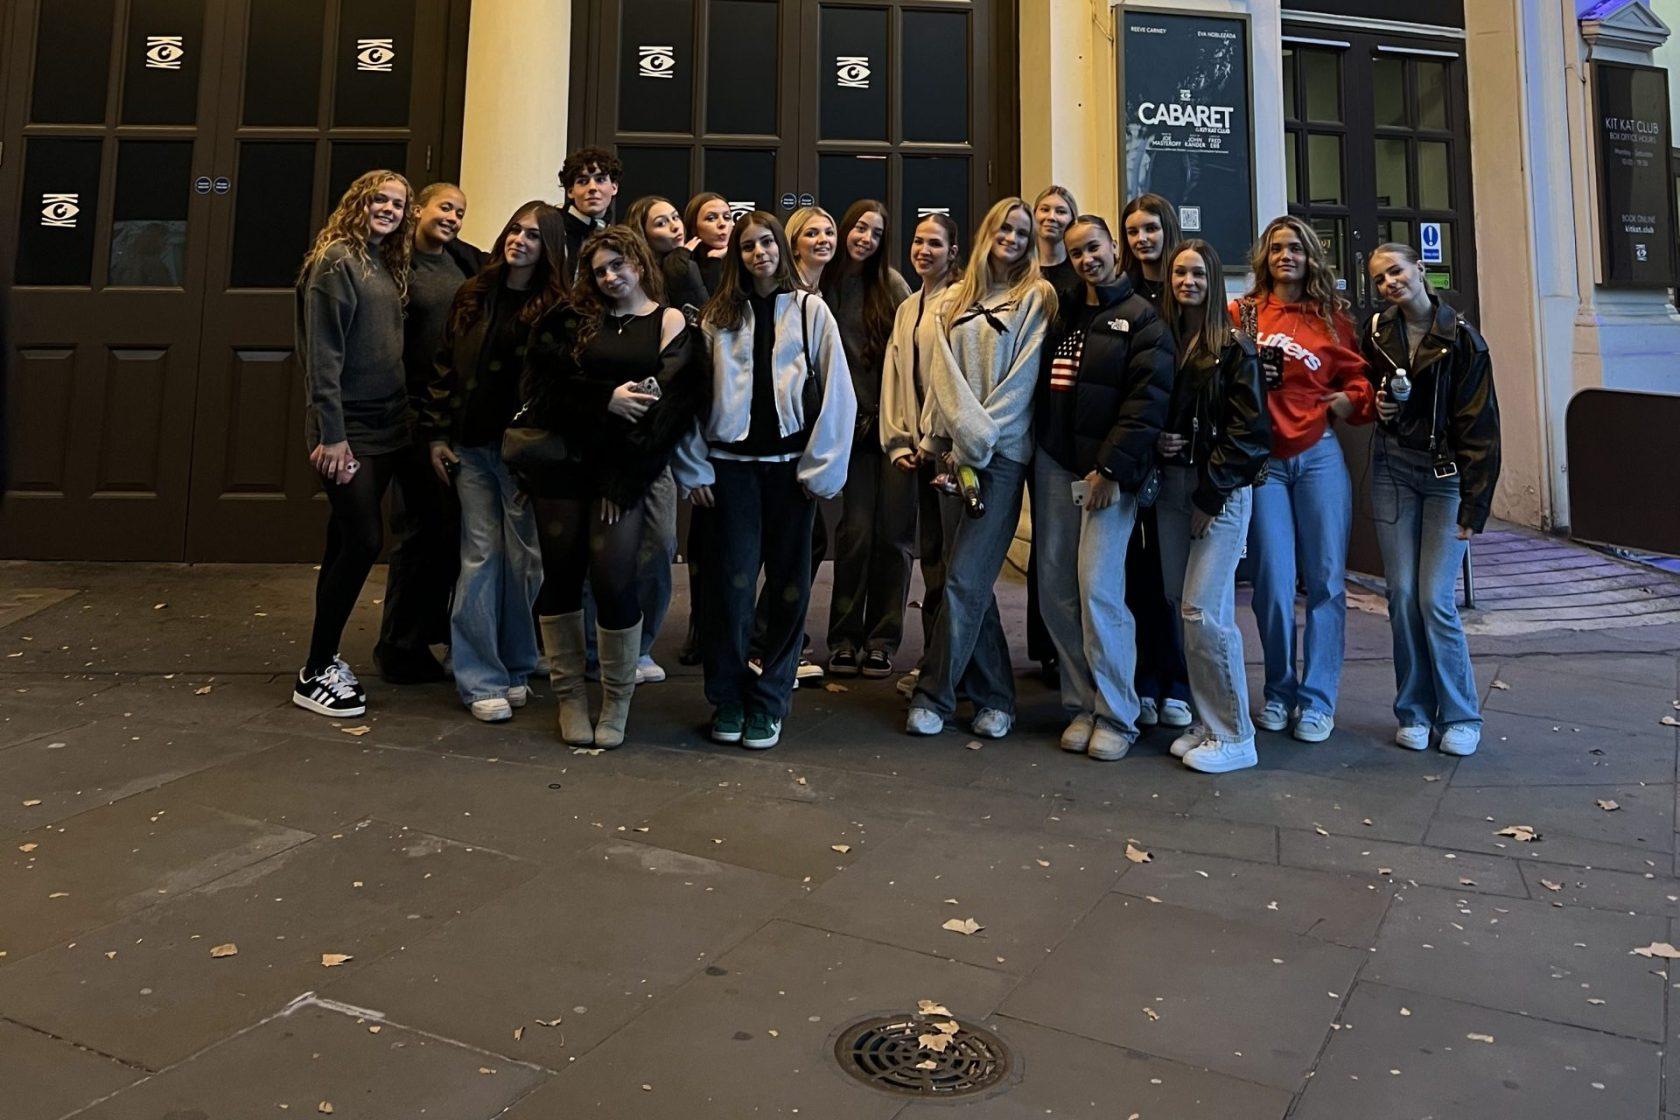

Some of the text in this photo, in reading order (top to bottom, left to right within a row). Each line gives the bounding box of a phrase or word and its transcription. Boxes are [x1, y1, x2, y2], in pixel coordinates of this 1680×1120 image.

[1138, 102, 1234, 128] CABARET
[1606, 117, 1659, 134] KIT KAT CLUB
[1622, 133, 1638, 142] OFFICE
[1622, 214, 1656, 224] BOOK ONLINE
